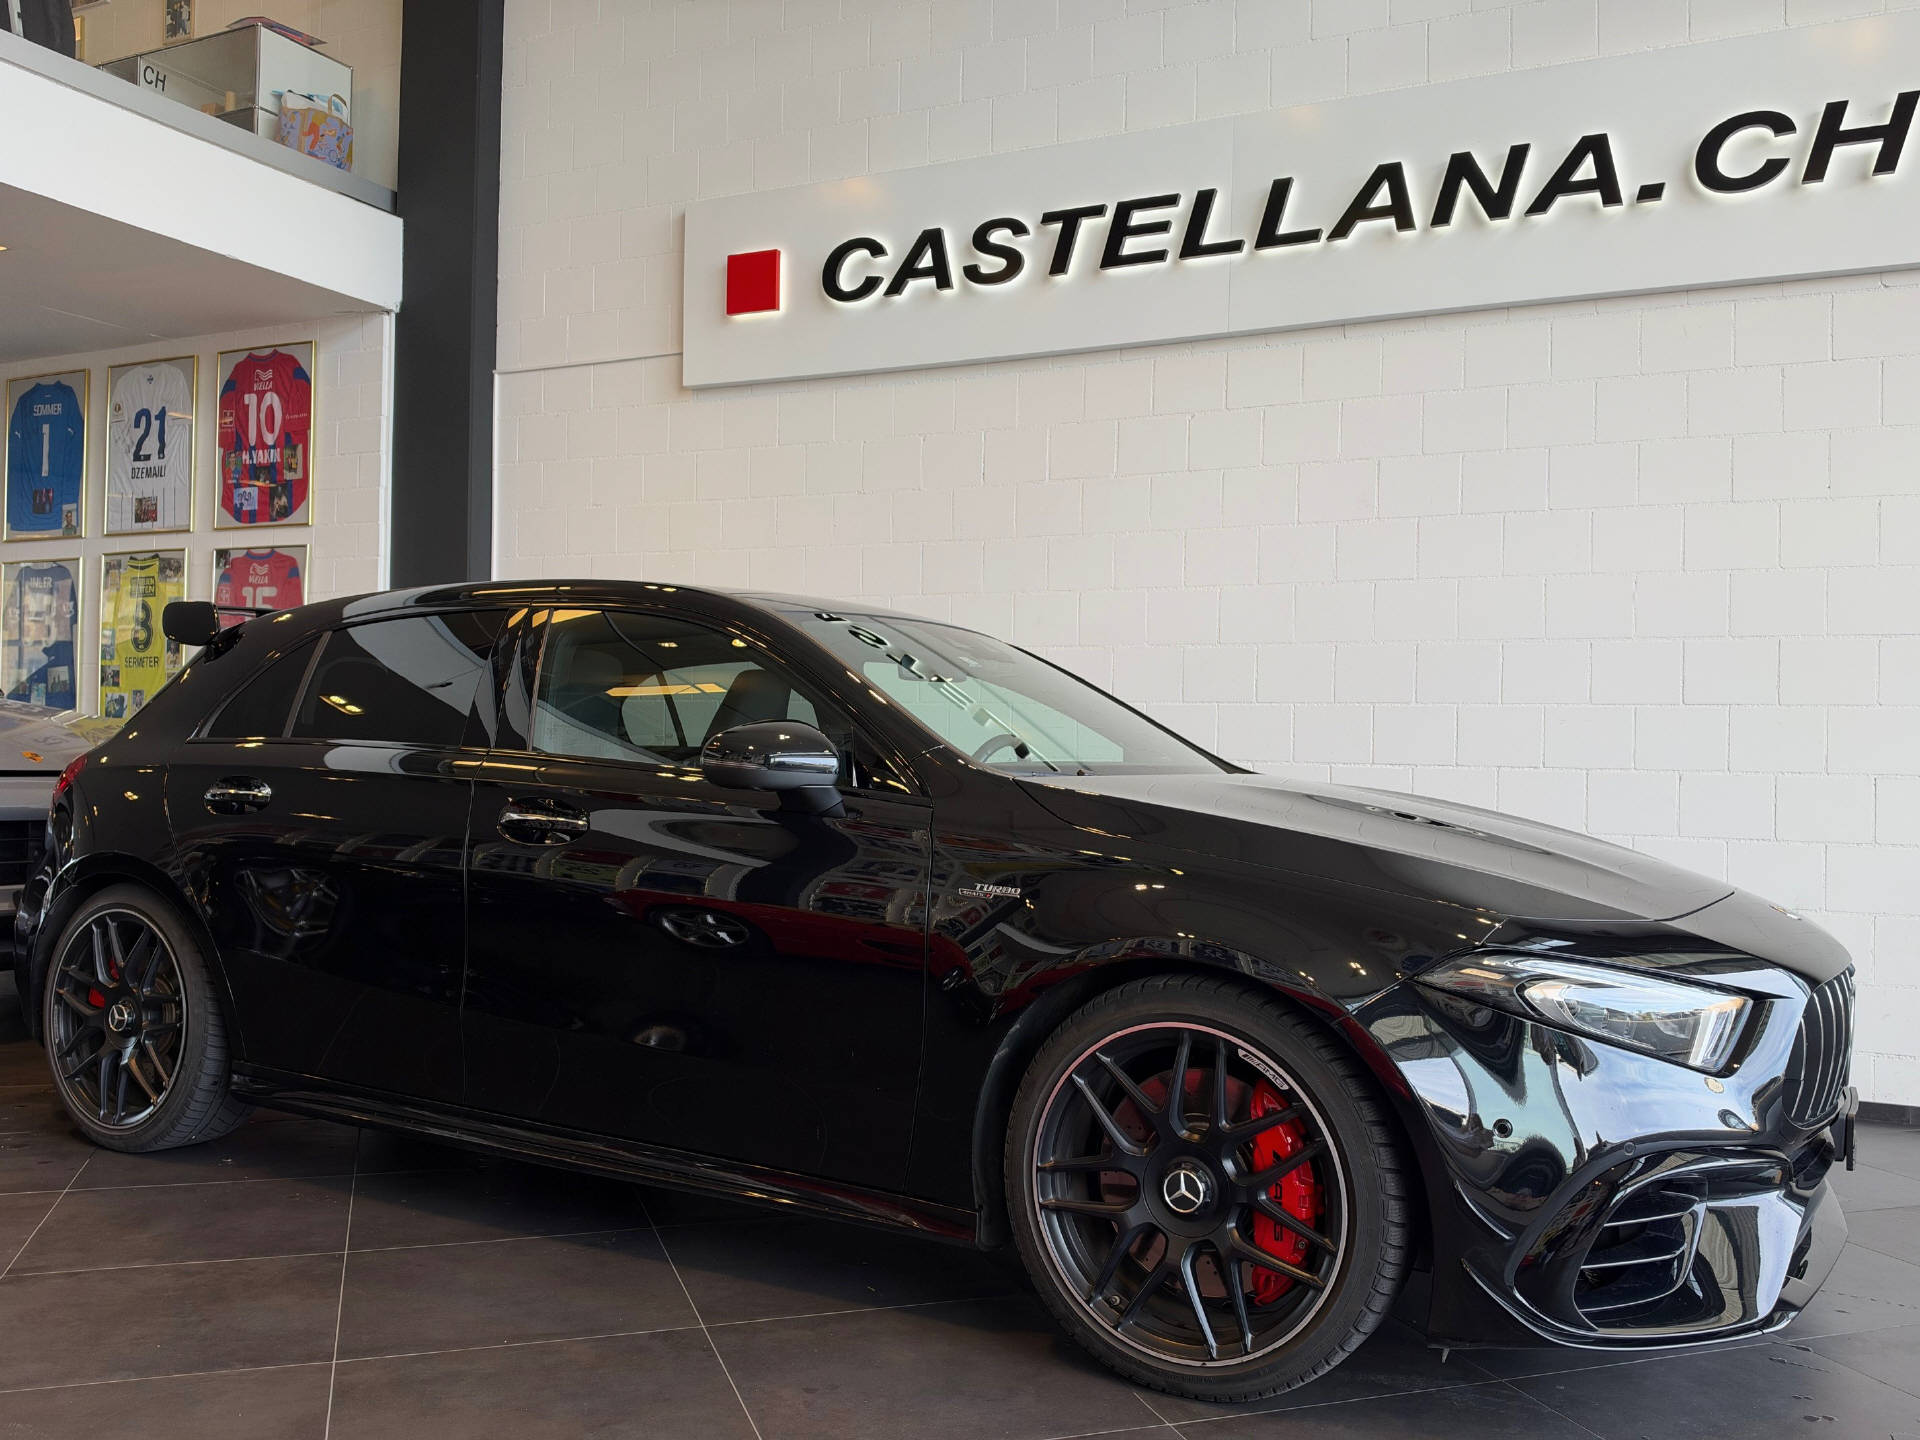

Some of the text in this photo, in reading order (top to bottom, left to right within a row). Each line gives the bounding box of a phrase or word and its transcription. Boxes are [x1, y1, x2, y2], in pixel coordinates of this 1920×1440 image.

[143, 65, 167, 92] CH
[822, 90, 1920, 302] CASTELLANA.CH
[33, 403, 62, 417] SOMMER
[244, 391, 283, 446] 10
[42, 423, 50, 477] 1
[133, 405, 167, 462] 21
[131, 464, 167, 480] DZEMAILI
[130, 599, 154, 653] 8
[124, 655, 160, 669] SERMETER
[974, 882, 1021, 895] TURBO
